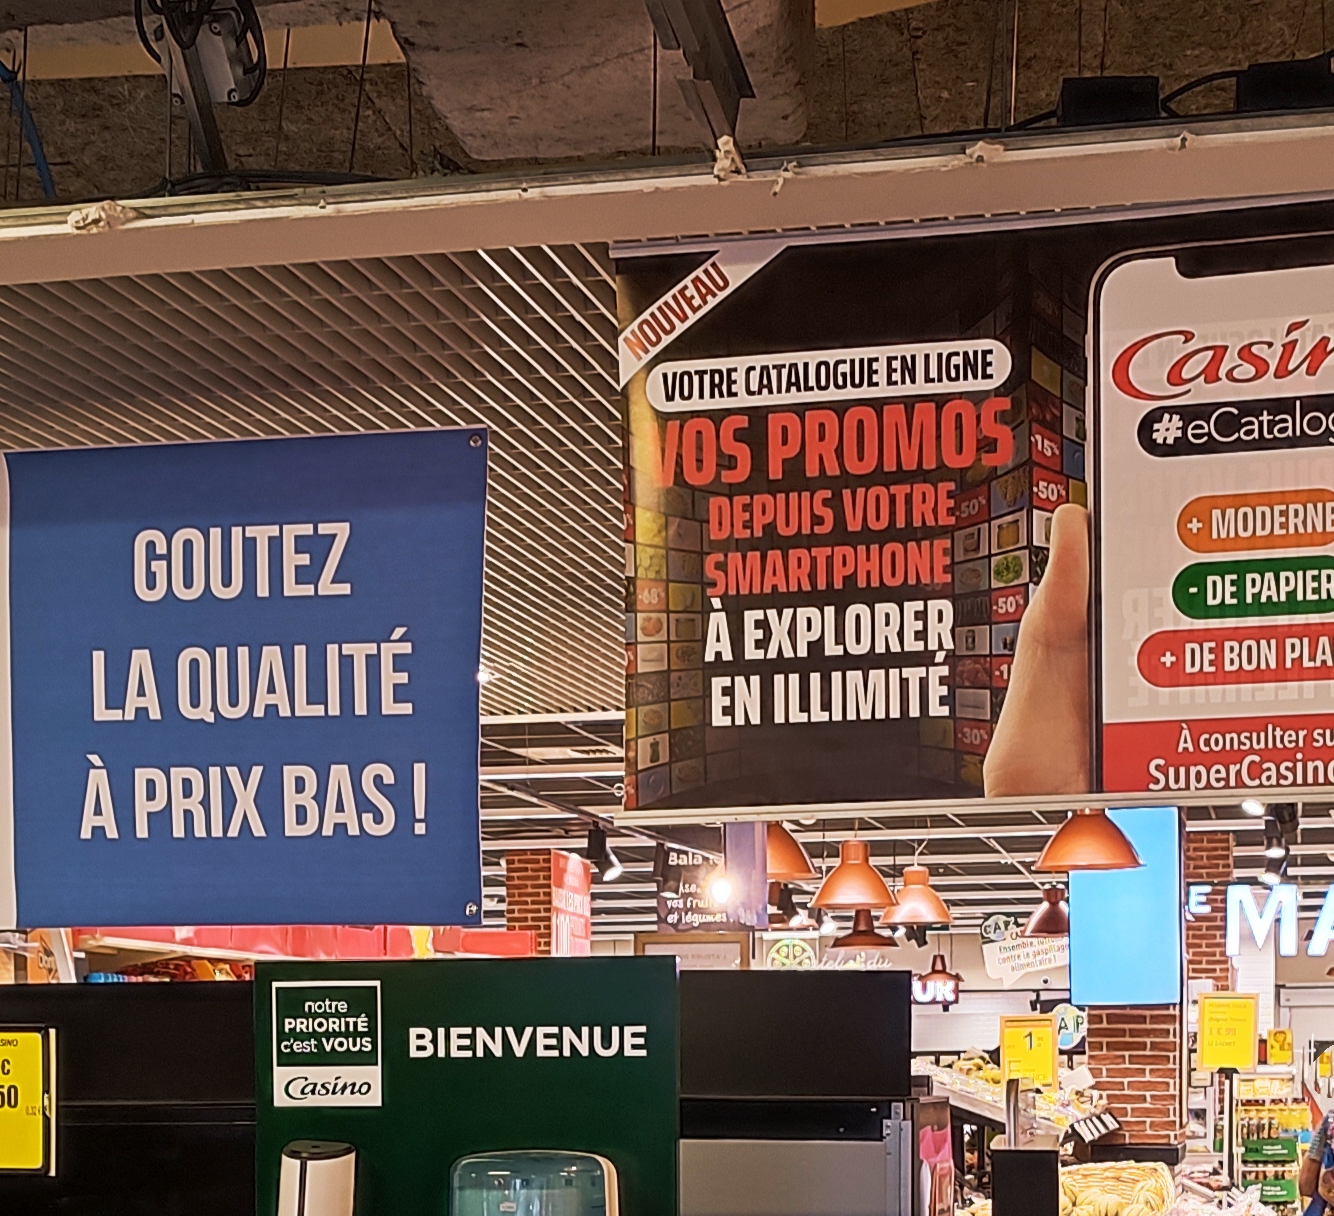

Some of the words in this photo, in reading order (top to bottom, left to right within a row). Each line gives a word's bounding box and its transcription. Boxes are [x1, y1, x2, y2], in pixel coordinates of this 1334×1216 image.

[623, 261, 731, 362] NOUVEAU
[662, 366, 739, 402] VOTRE
[745, 357, 880, 396] CATALOGUE
[886, 353, 917, 386] EN
[924, 349, 995, 384] LIGNE
[651, 413, 752, 489] VOS
[767, 397, 1015, 480] PROMOS
[708, 489, 835, 541] DEPUIS
[842, 481, 957, 532] VOTRE
[133, 522, 351, 603] GOUTEZ
[704, 538, 952, 597] SMARTPHONE
[1206, 574, 1238, 606] DE
[704, 597, 733, 663] À
[744, 598, 955, 661] EXPLORER
[1185, 641, 1216, 673] DE
[1224, 638, 1277, 672] BON
[92, 647, 162, 722] LA
[177, 626, 413, 724] QUALITÉ
[710, 674, 762, 727] EN
[773, 651, 951, 724] ILLIMITÉ
[1177, 724, 1194, 753] À
[1199, 724, 1307, 752] consulter
[79, 753, 119, 841] À
[135, 764, 266, 839] PRIX
[284, 762, 397, 837] BAS
[284, 1013, 369, 1033] PRIORITÉ
[304, 998, 348, 1013] notre
[280, 1038, 318, 1053] c'est
[321, 1037, 373, 1053] VOUS
[408, 1025, 648, 1058] BIENVENUE
[284, 1075, 372, 1101] Casino
